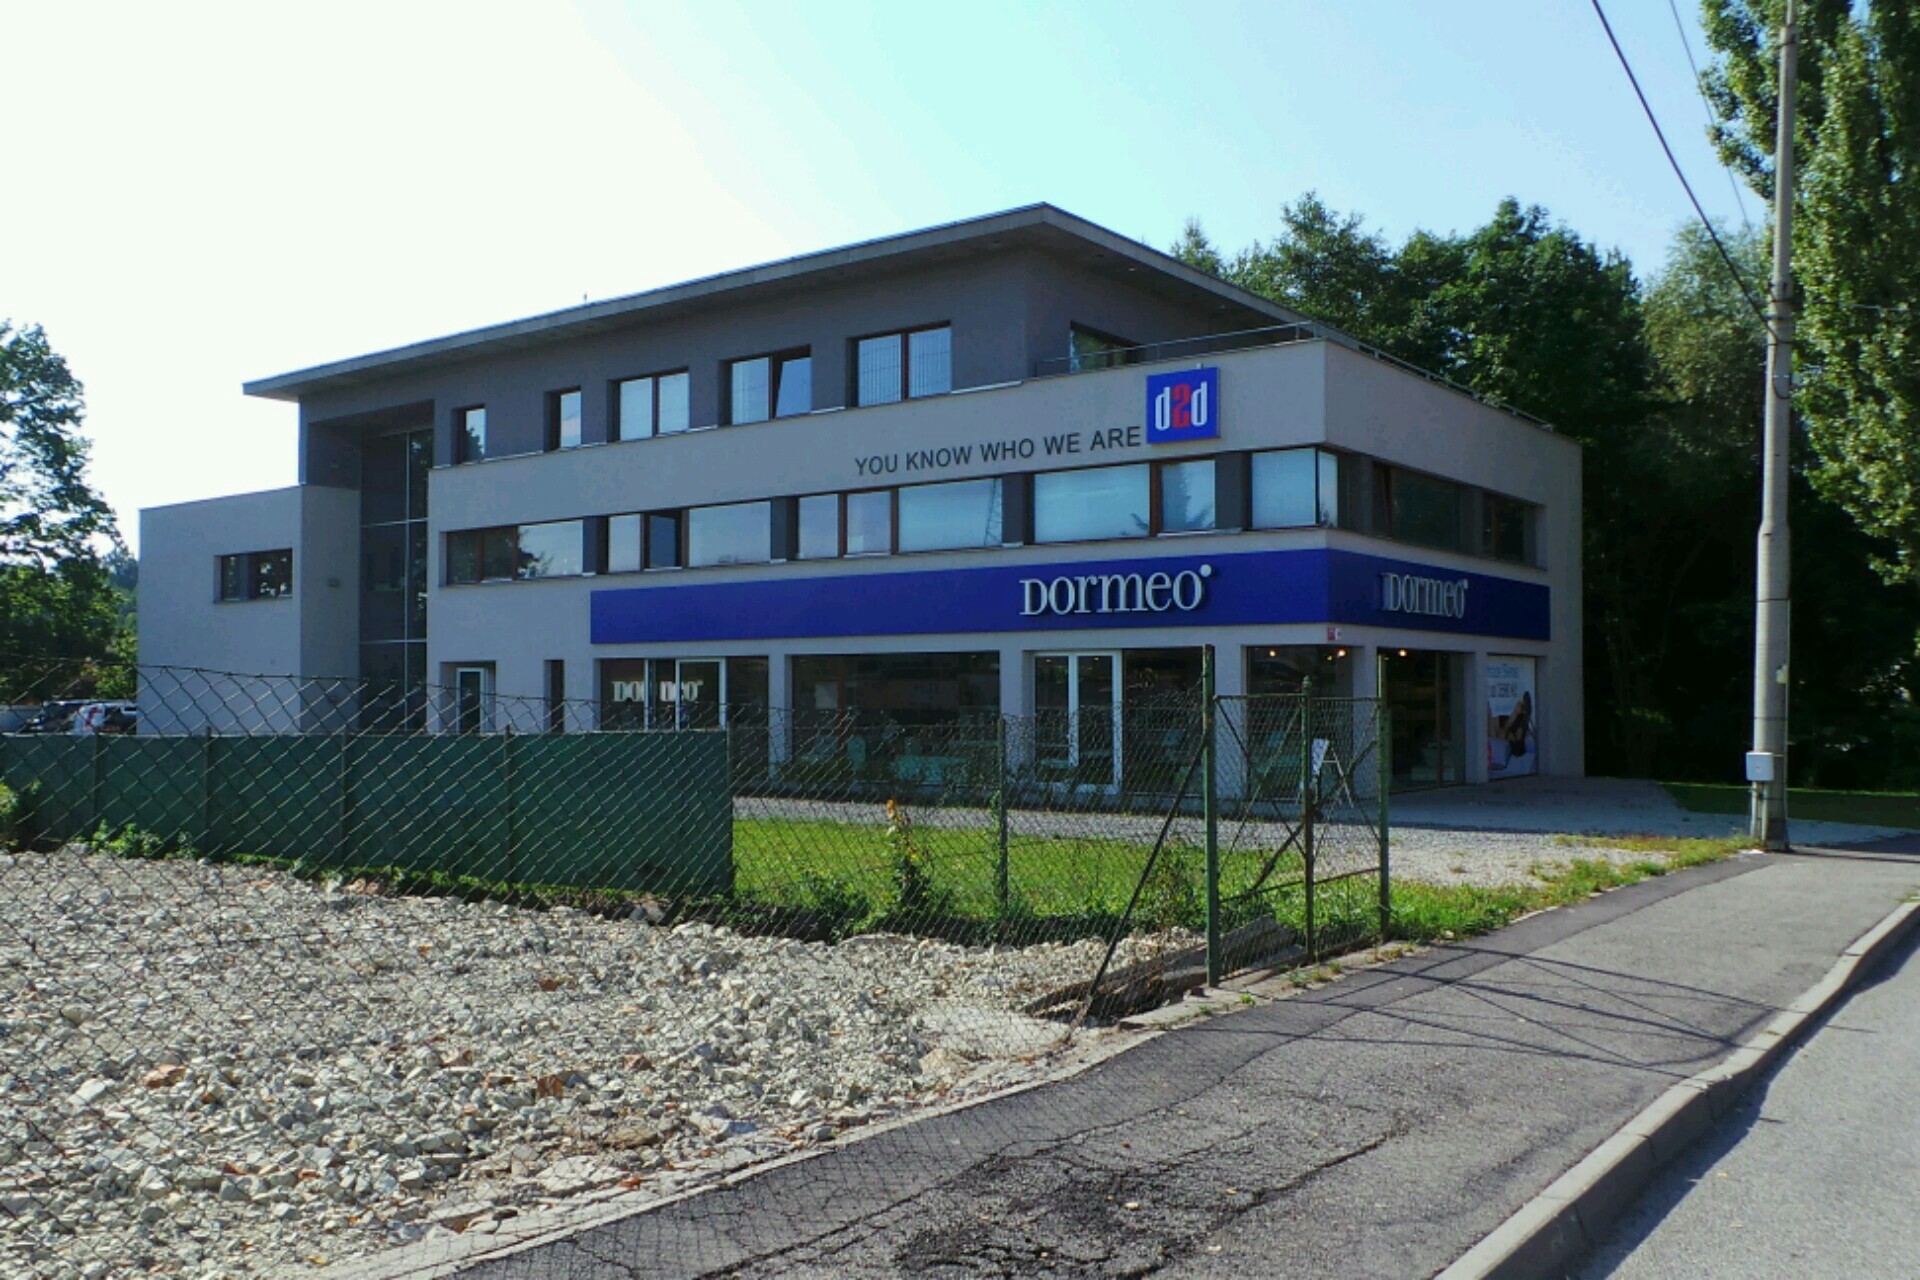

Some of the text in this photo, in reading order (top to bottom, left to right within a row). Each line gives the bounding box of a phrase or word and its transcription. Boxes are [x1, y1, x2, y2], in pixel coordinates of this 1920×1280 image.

[1155, 381, 1208, 431] d2d
[855, 426, 1141, 476] YOU KNOW WHO WE ARE
